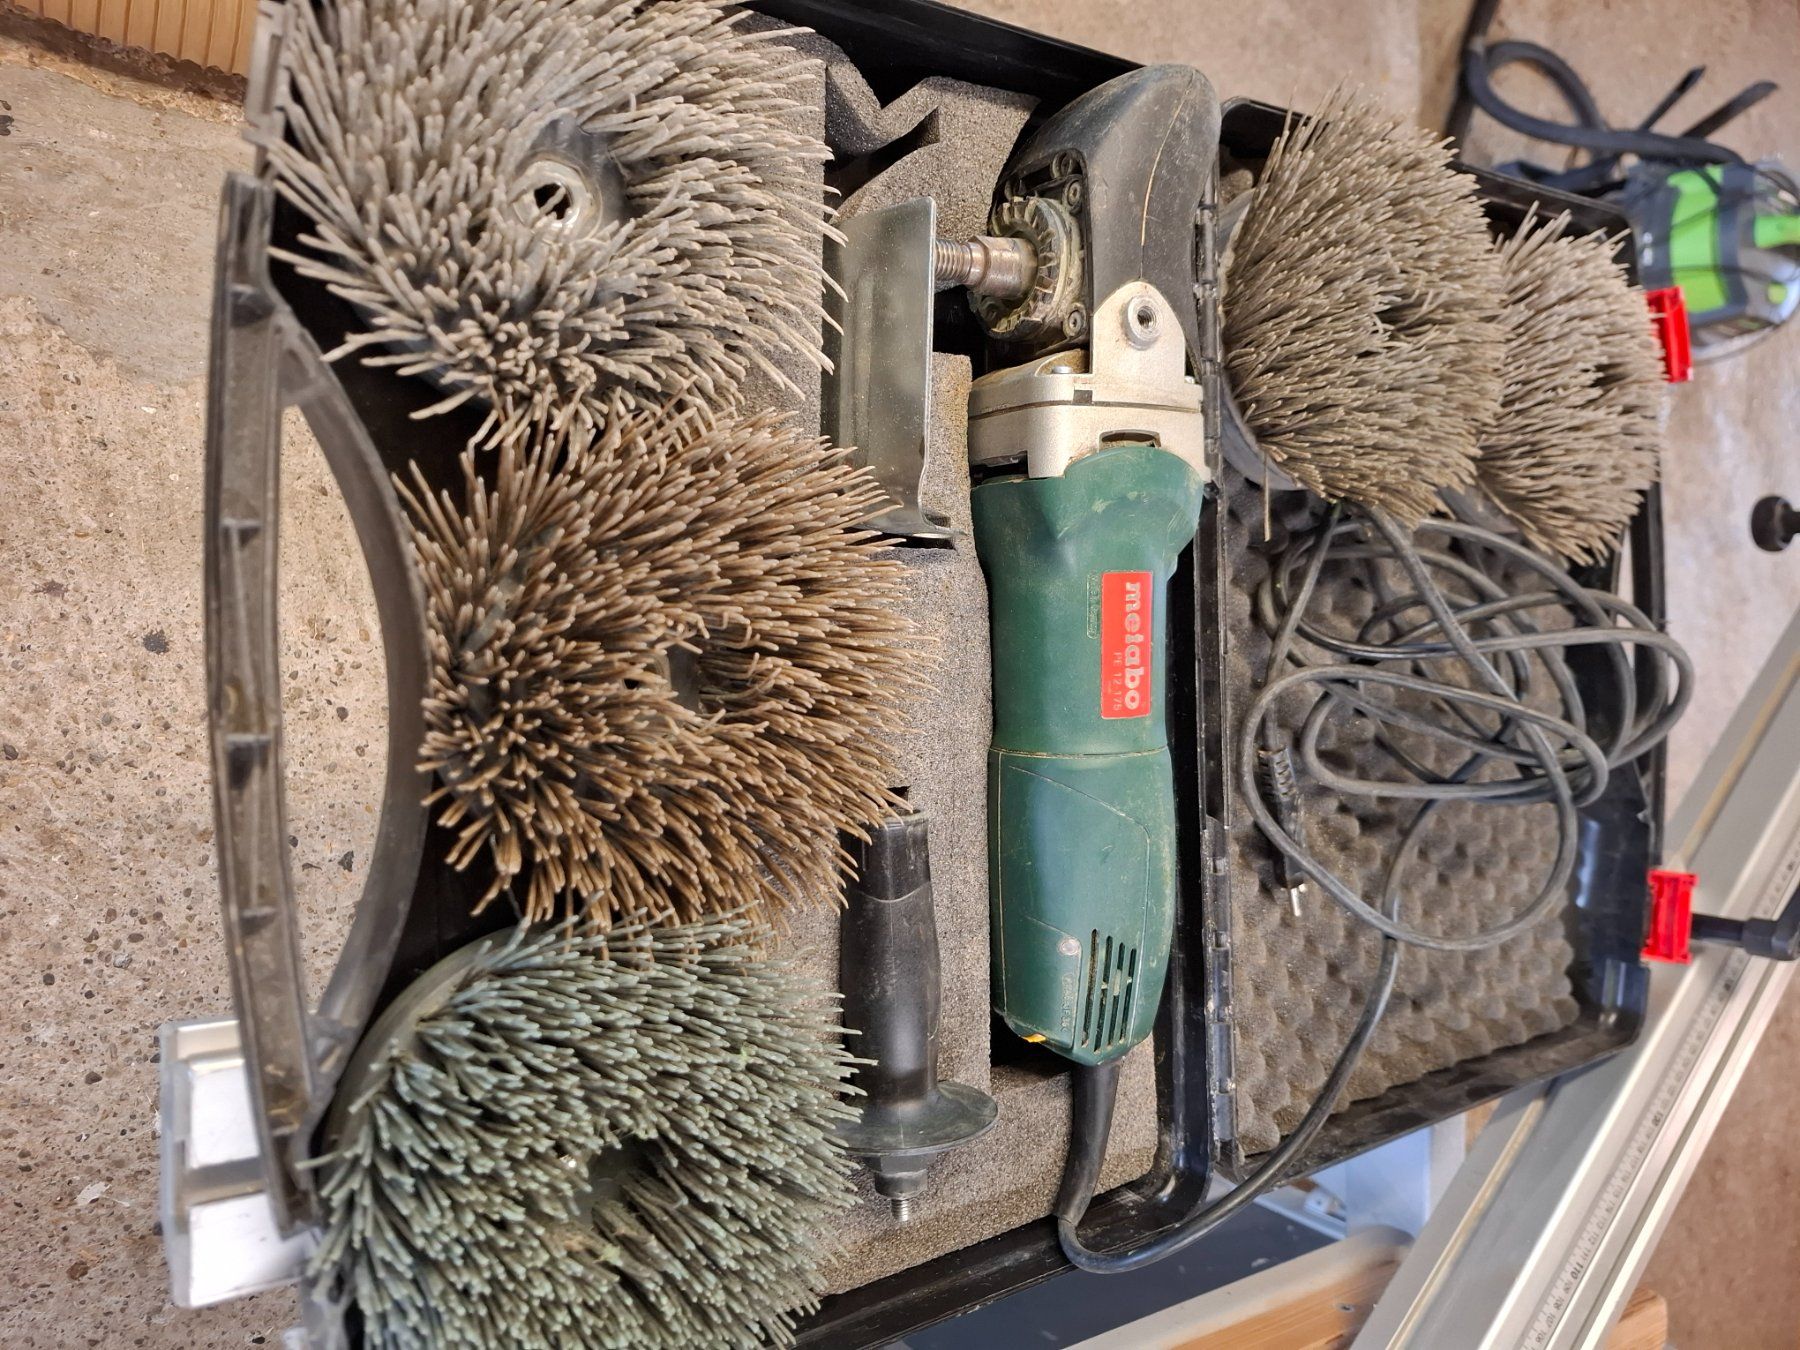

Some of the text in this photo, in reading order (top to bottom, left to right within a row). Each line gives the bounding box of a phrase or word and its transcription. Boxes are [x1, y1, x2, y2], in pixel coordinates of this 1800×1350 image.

[1125, 582, 1146, 710] metabo
[1113, 652, 1123, 666] PE
[1570, 1262, 1583, 1280] 110
[1545, 1313, 1556, 1328] 107
